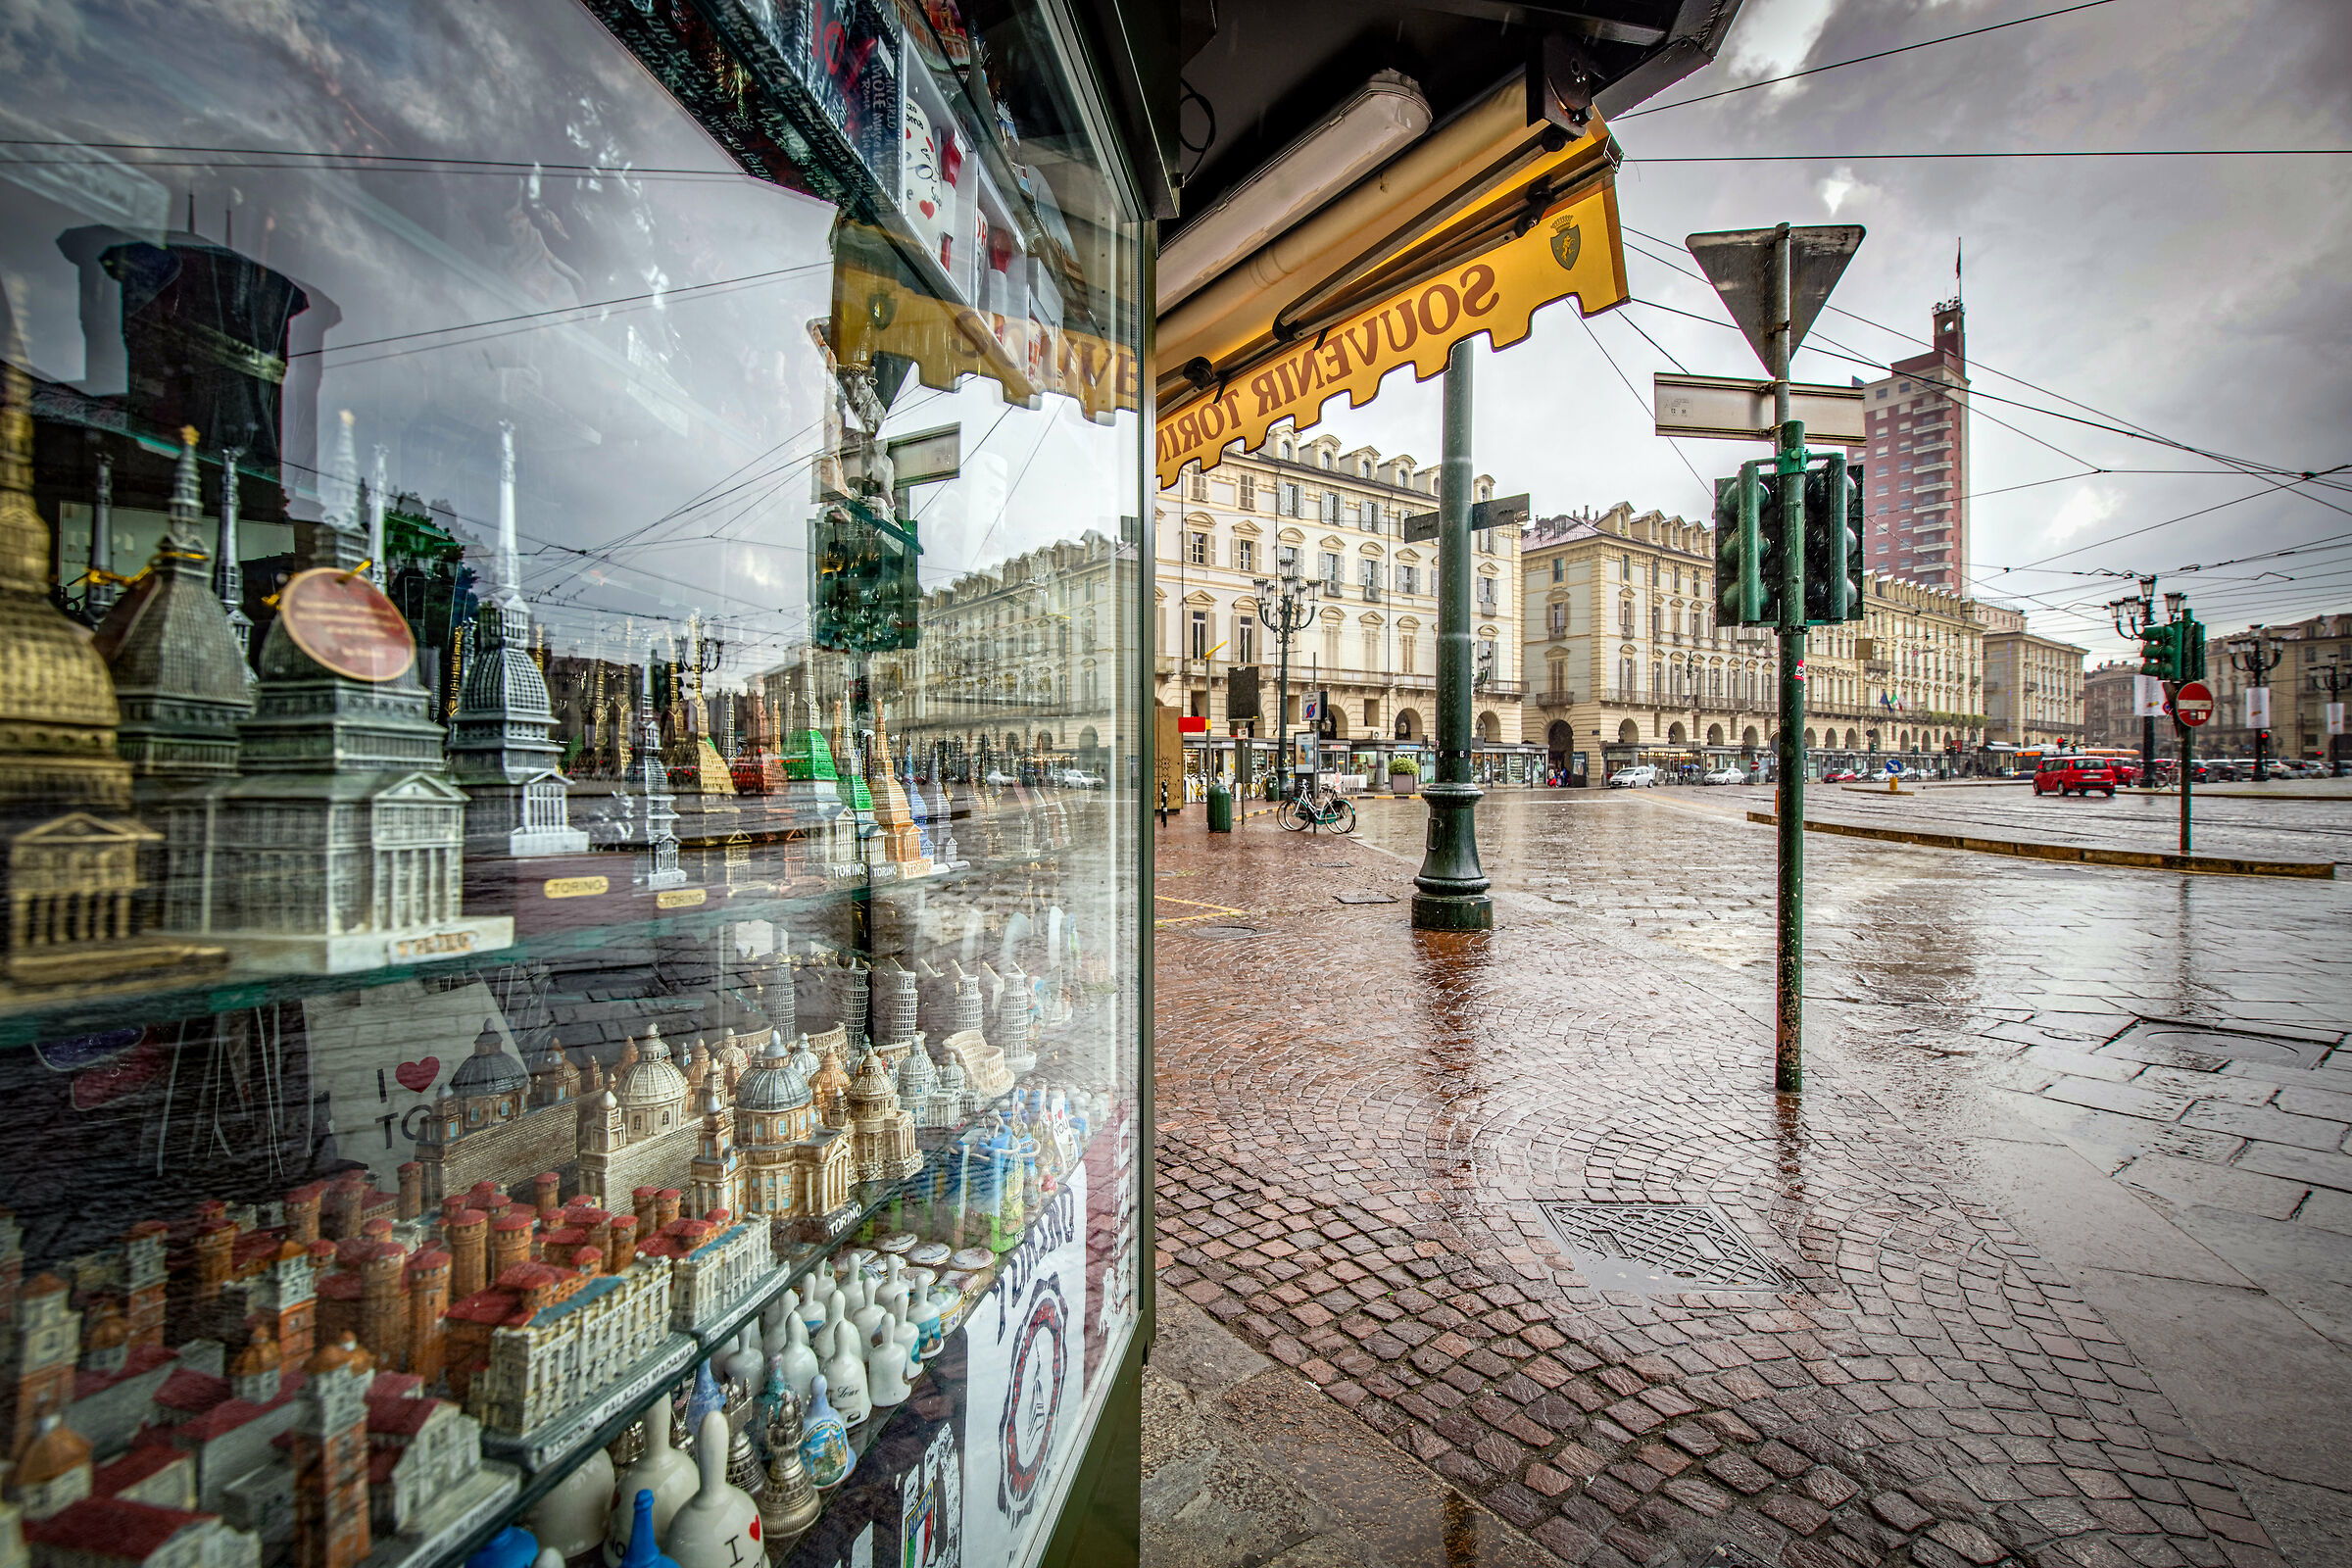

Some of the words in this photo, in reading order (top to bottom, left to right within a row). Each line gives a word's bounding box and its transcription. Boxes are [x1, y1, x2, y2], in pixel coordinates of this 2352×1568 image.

[832, 862, 865, 879] TORINO
[872, 864, 898, 878] TORINO
[552, 879, 602, 894] TORINO
[828, 1203, 862, 1237] TORINO
[908, 1494, 933, 1538] ITALIA
